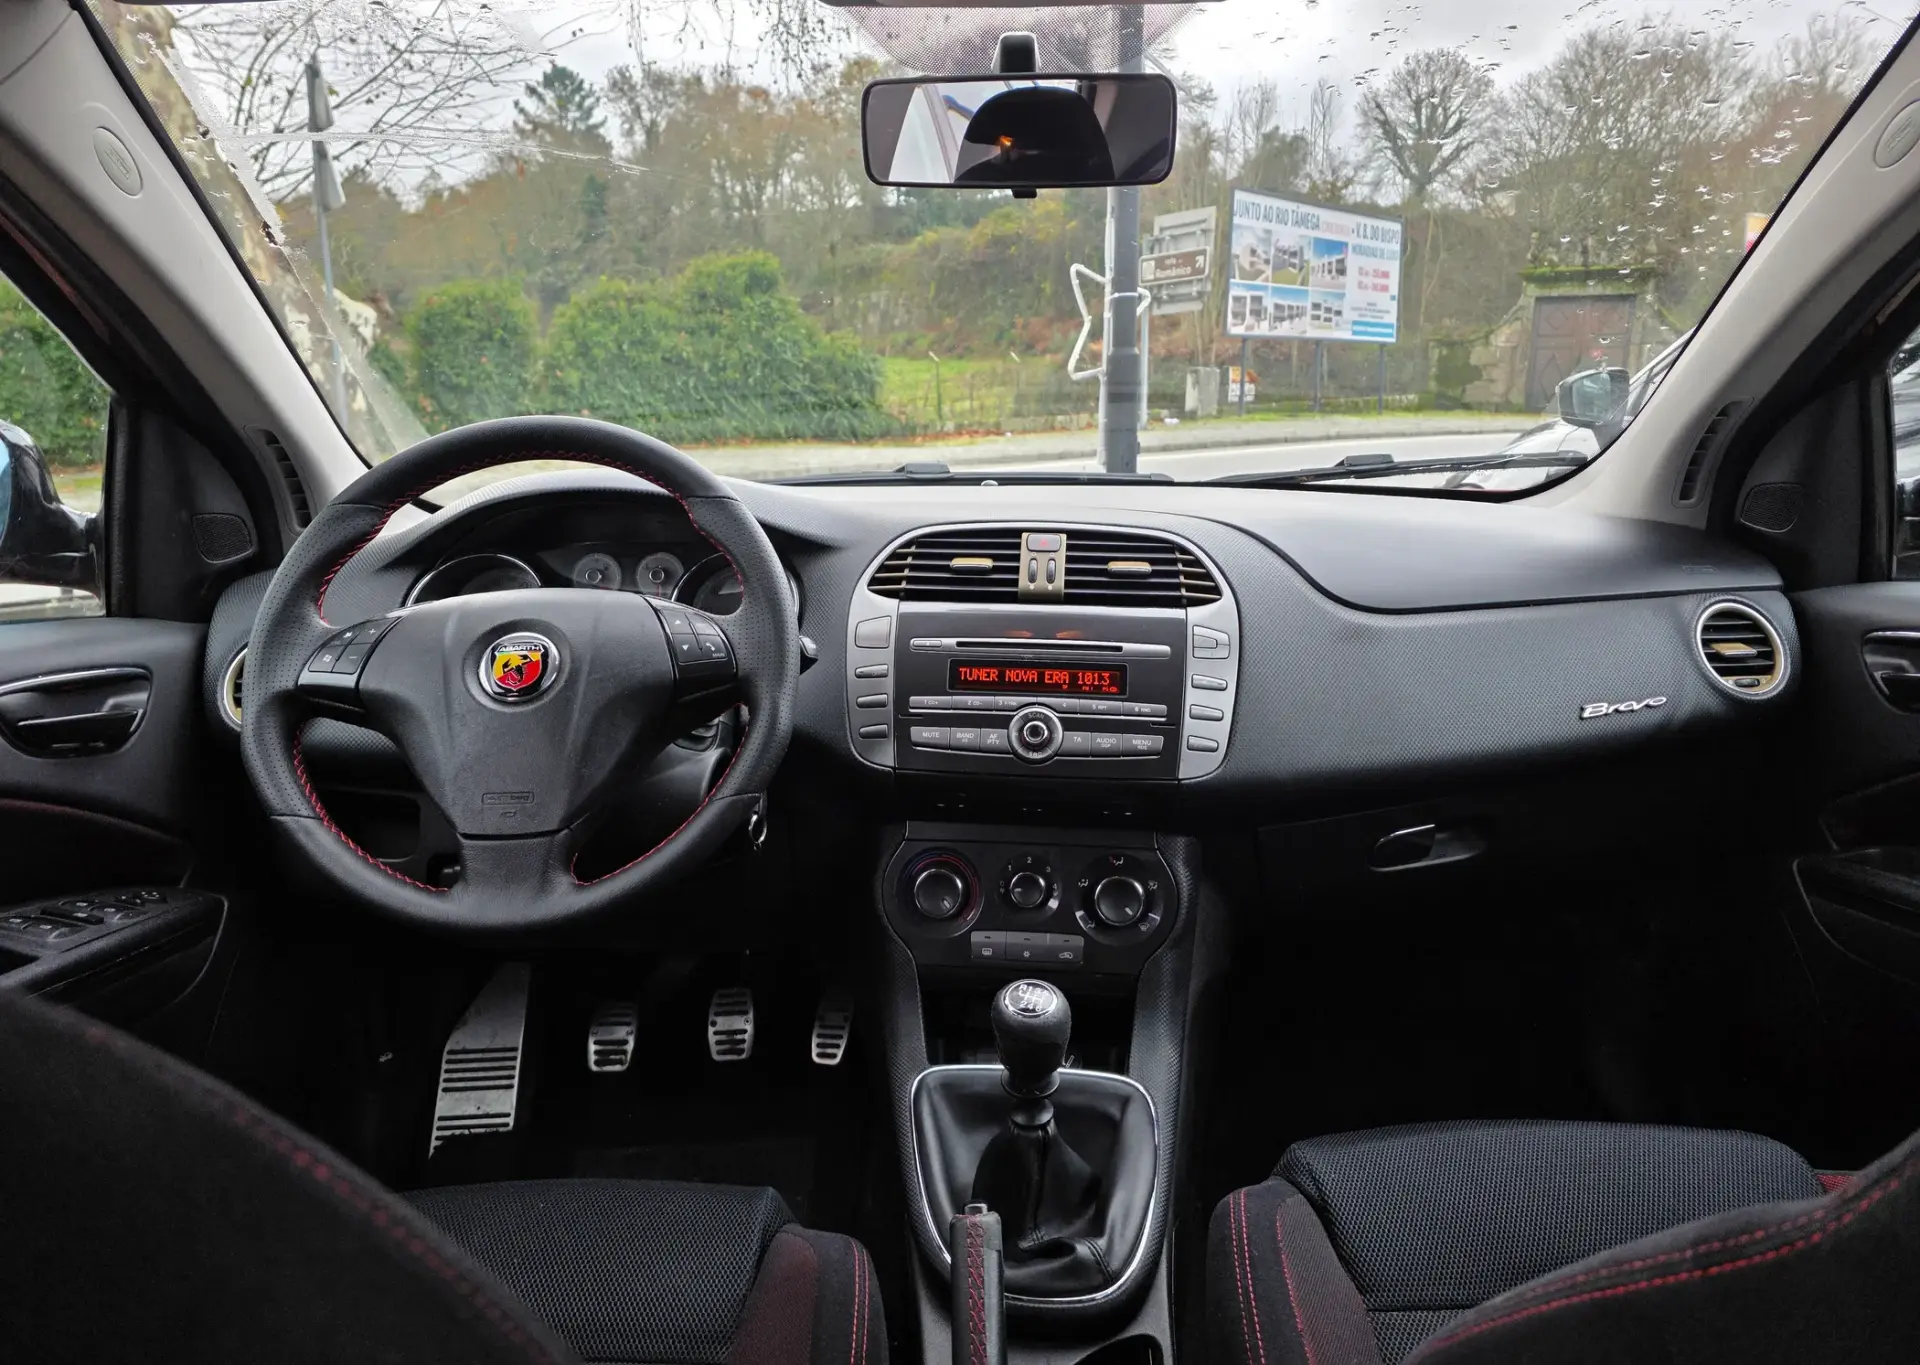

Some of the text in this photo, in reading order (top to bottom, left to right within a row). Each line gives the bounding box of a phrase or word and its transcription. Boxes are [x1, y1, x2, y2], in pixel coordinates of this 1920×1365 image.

[1233, 197, 1260, 221] JUNTO
[1262, 204, 1273, 223] AO
[1275, 206, 1289, 226] RIO
[1291, 204, 1320, 231] TÂMEGA
[1370, 225, 1379, 241] DO
[1381, 227, 1399, 244] BISPO
[960, 667, 998, 681] TUNER
[1005, 669, 1037, 682] NOVA
[1045, 671, 1069, 684] ERA
[1026, 856, 1032, 864] 2
[1020, 1000, 1027, 1008] 2
